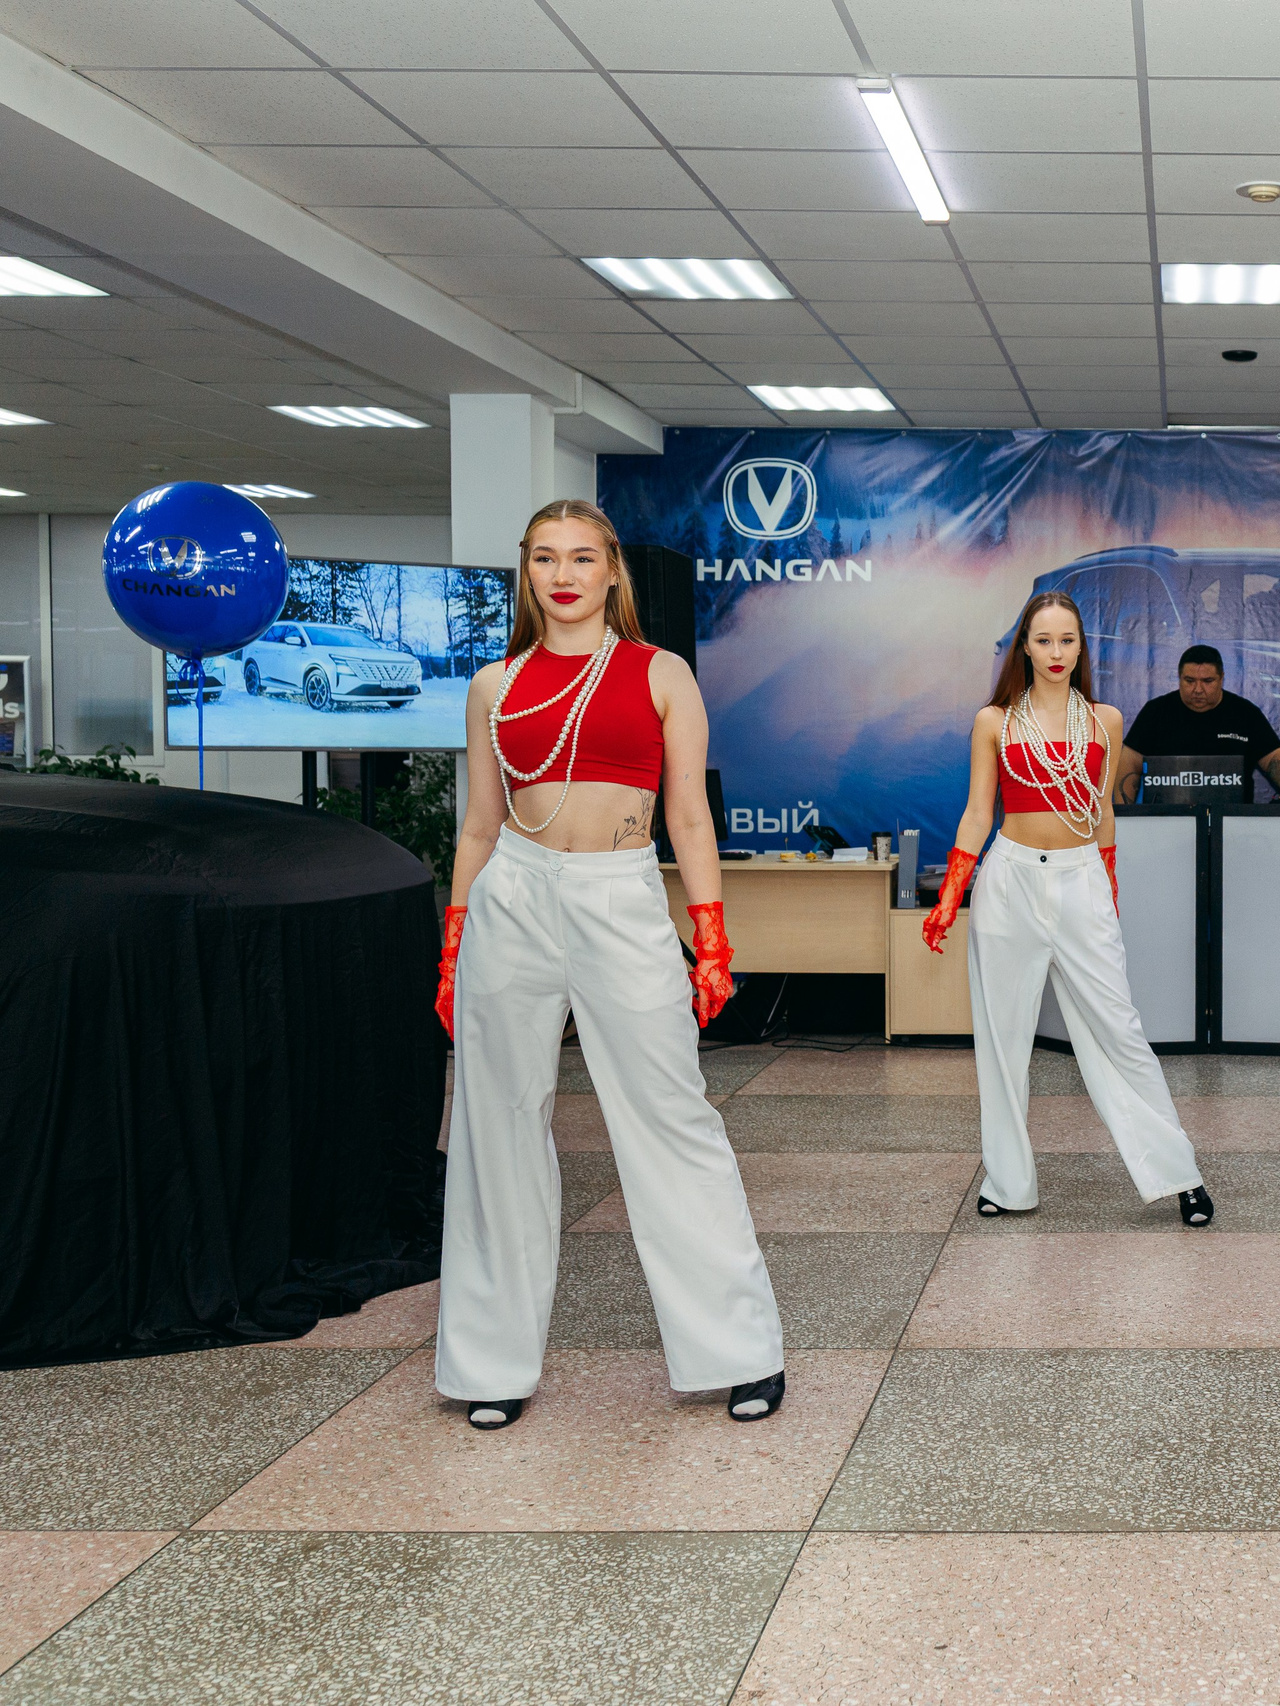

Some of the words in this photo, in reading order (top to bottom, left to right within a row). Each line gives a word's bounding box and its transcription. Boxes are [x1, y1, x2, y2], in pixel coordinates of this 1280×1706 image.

[696, 558, 872, 582] HANGAN
[122, 578, 236, 597] CHANGAN
[1144, 771, 1242, 786] soundBratsk
[725, 801, 820, 833] ВЫЙ
